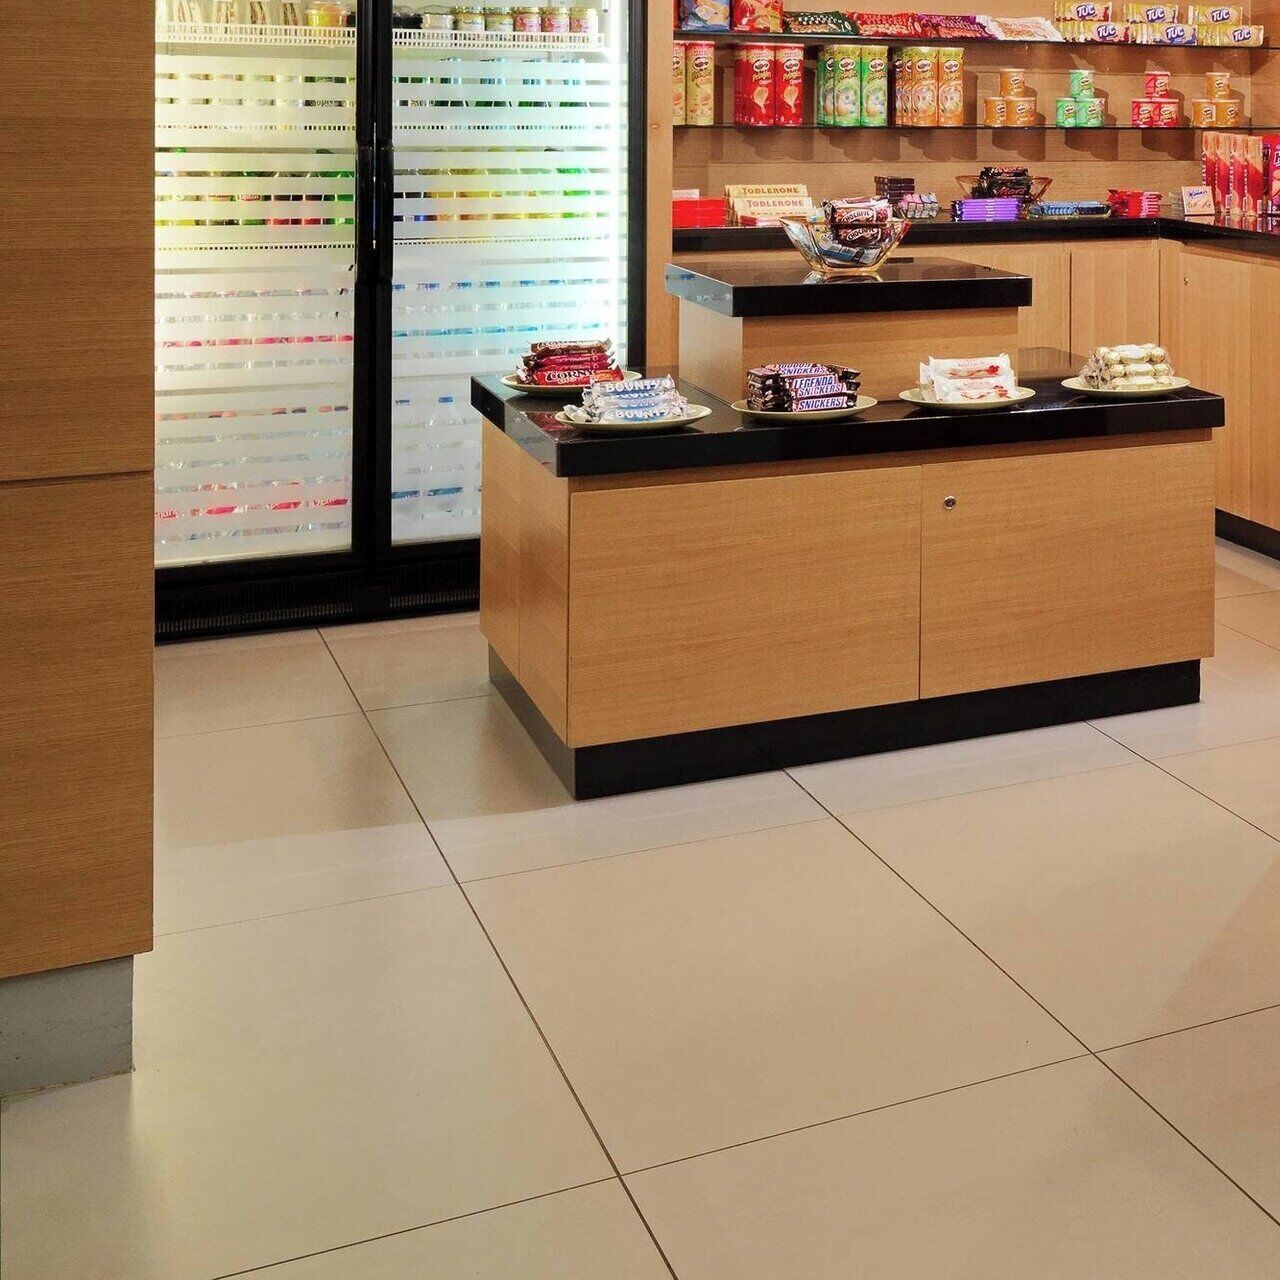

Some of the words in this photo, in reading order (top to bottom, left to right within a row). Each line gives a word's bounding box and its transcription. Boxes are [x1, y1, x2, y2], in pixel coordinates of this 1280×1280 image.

[1076, 3, 1095, 18] TUC
[1146, 5, 1165, 20] TUC
[1211, 6, 1230, 22] TUC
[1097, 23, 1116, 38] TUC
[1166, 24, 1185, 39] TUC
[1233, 26, 1251, 42] TUC
[741, 187, 799, 195] TOBLERONE
[747, 200, 804, 208] TOBLERONE
[546, 370, 595, 382] CORNY
[781, 367, 828, 376] SNICKERS
[605, 380, 661, 393] BOUNTY
[799, 385, 842, 397] SNICKERS
[799, 398, 843, 410] SNICKERS
